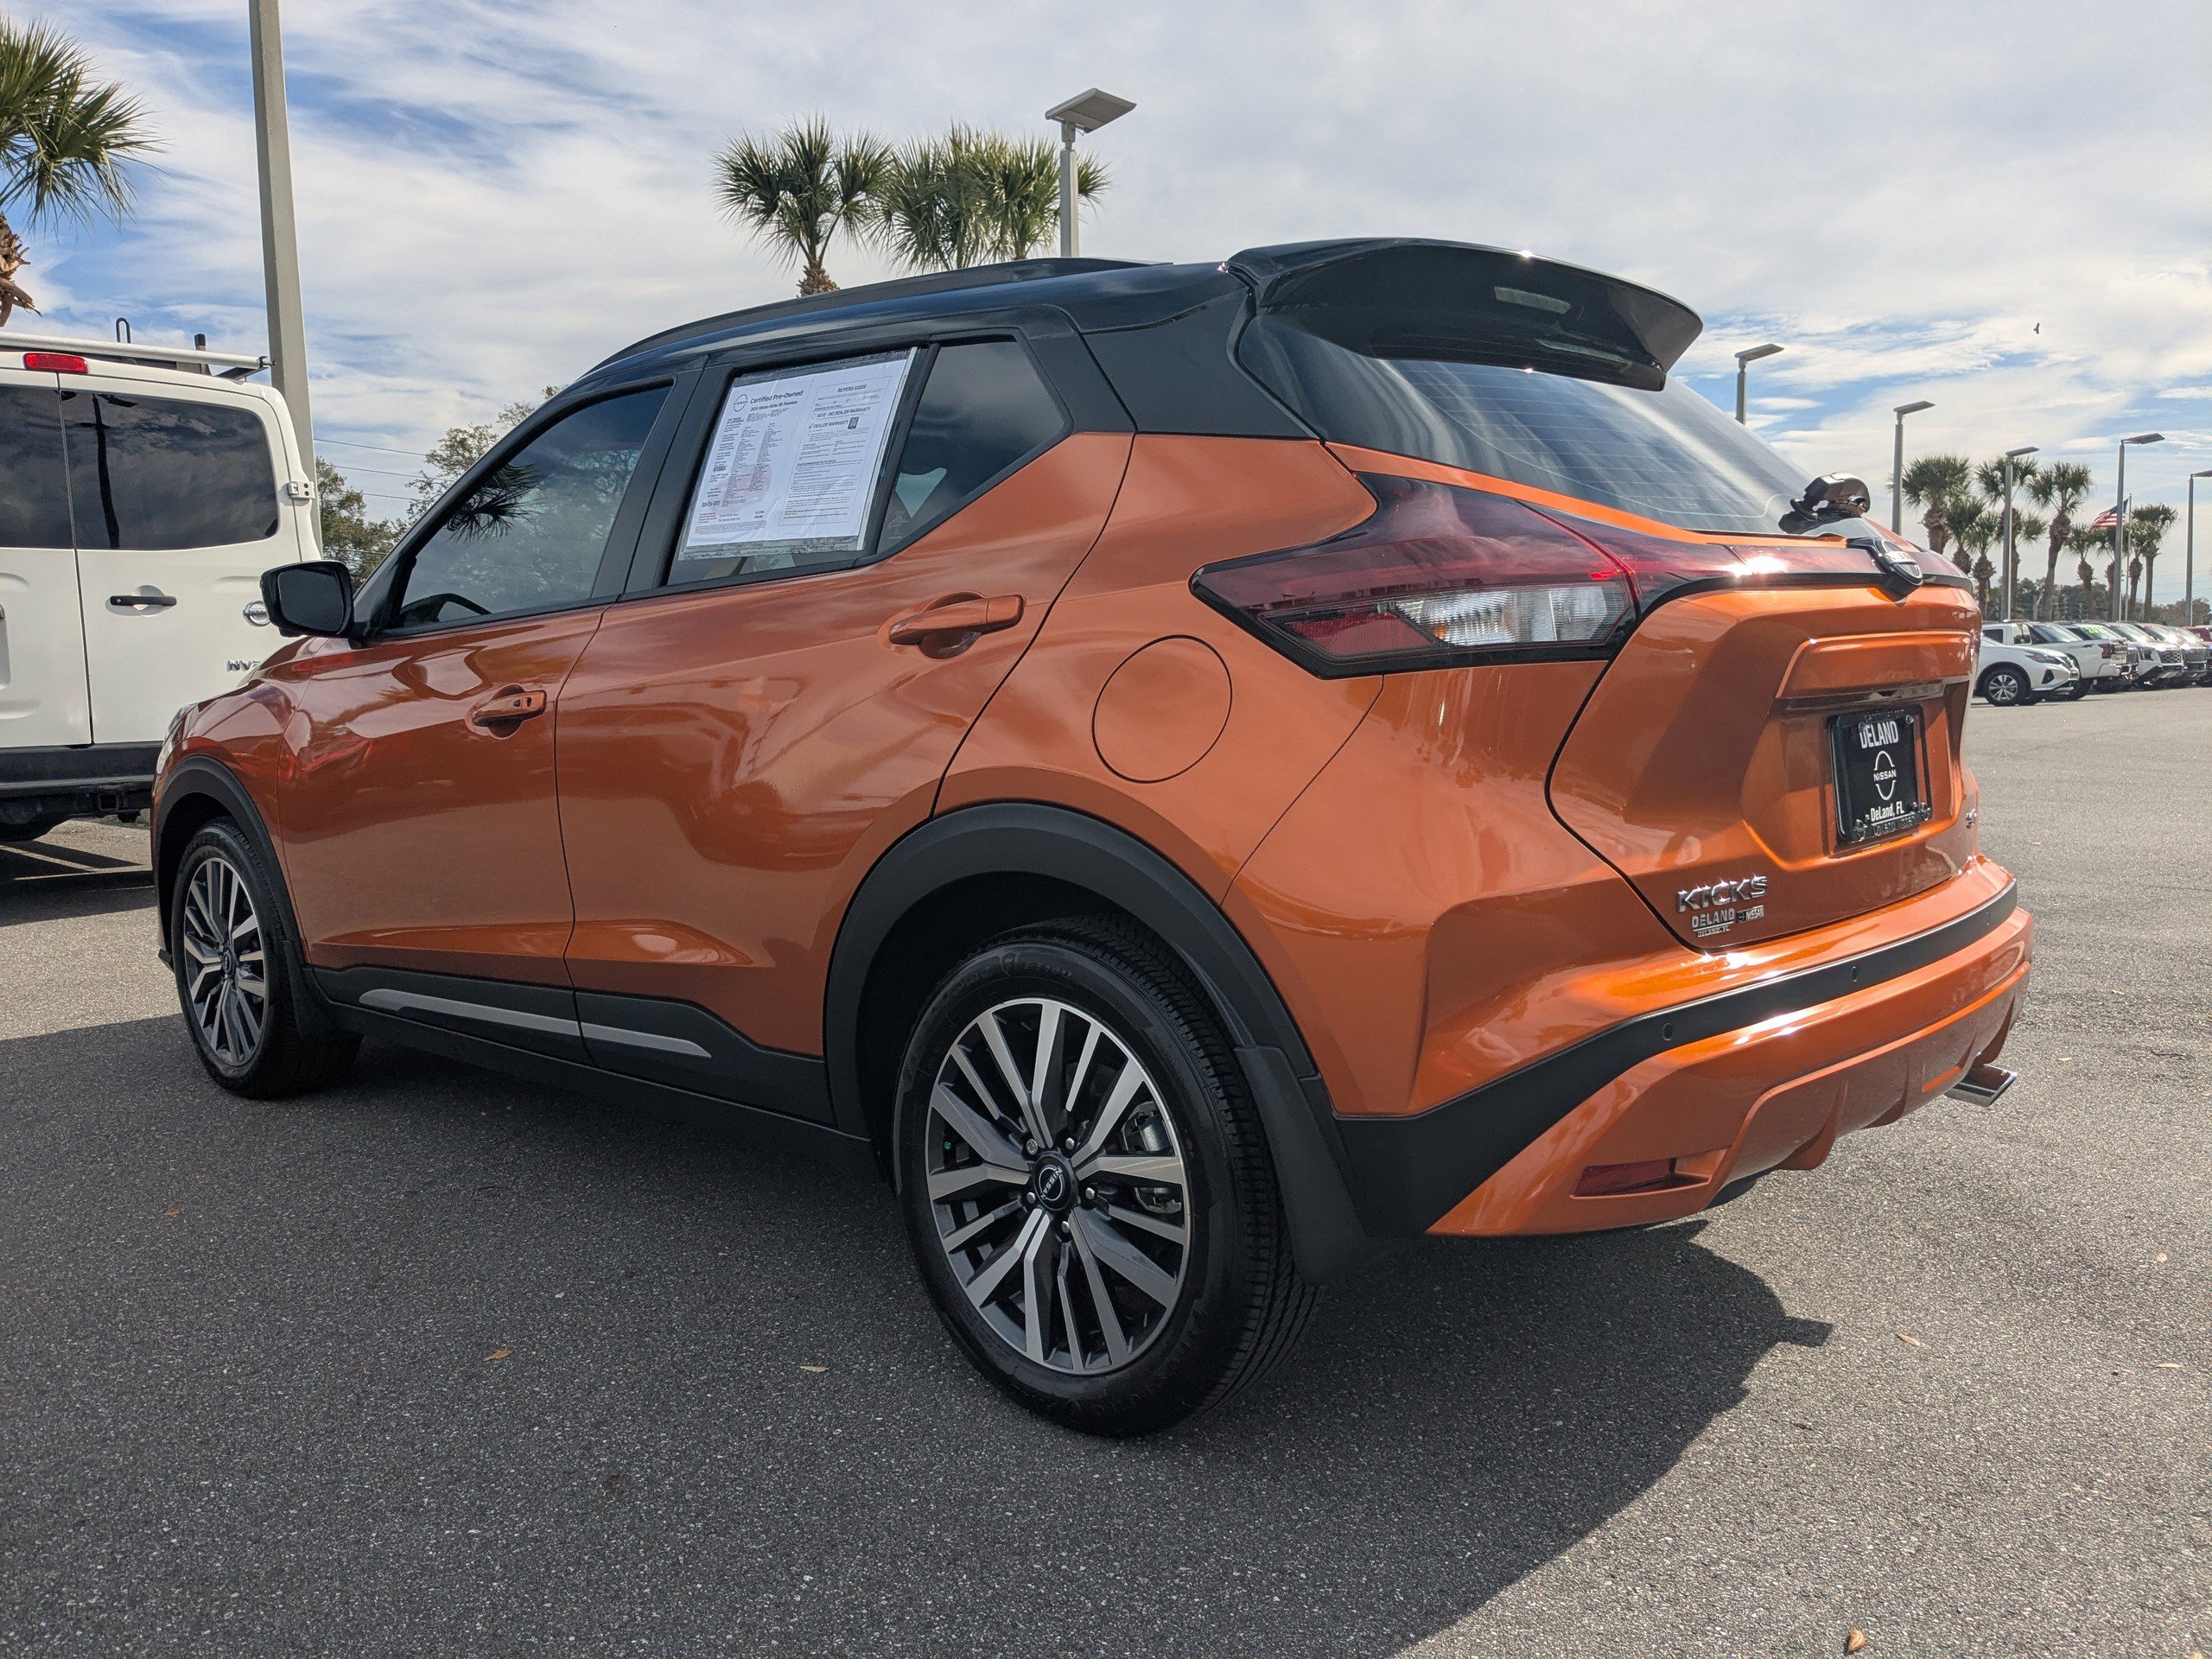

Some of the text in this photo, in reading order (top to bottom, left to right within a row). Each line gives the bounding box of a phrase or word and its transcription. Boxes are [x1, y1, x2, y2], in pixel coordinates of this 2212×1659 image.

[750, 390, 804, 404] Certified Pre-Owned
[1859, 720, 1899, 749] DELAND
[1872, 769, 1897, 782] NISSAN
[1870, 800, 1905, 822] DeLand, FL
[1677, 875, 1769, 912] KICKS
[1691, 907, 1736, 929] DELAND
[1040, 1166, 1063, 1200] NISSAN
